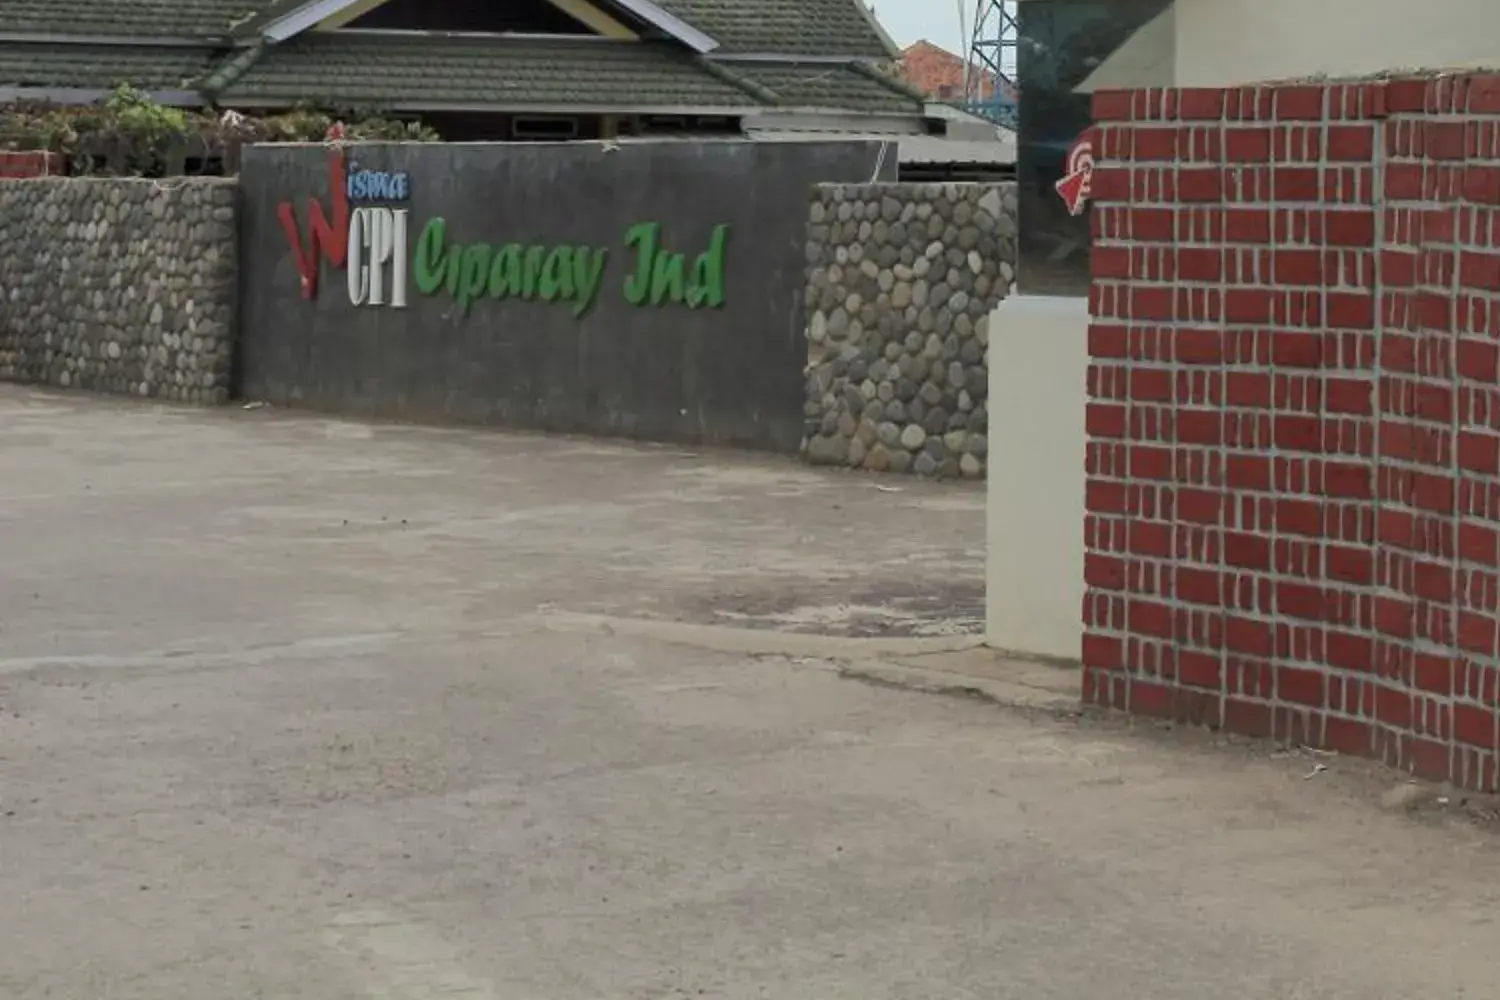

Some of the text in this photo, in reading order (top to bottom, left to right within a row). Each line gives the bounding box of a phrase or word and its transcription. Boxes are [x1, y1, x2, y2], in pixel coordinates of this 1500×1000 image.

[348, 207, 408, 307] CPI
[414, 217, 732, 320] Ciparay Ind
